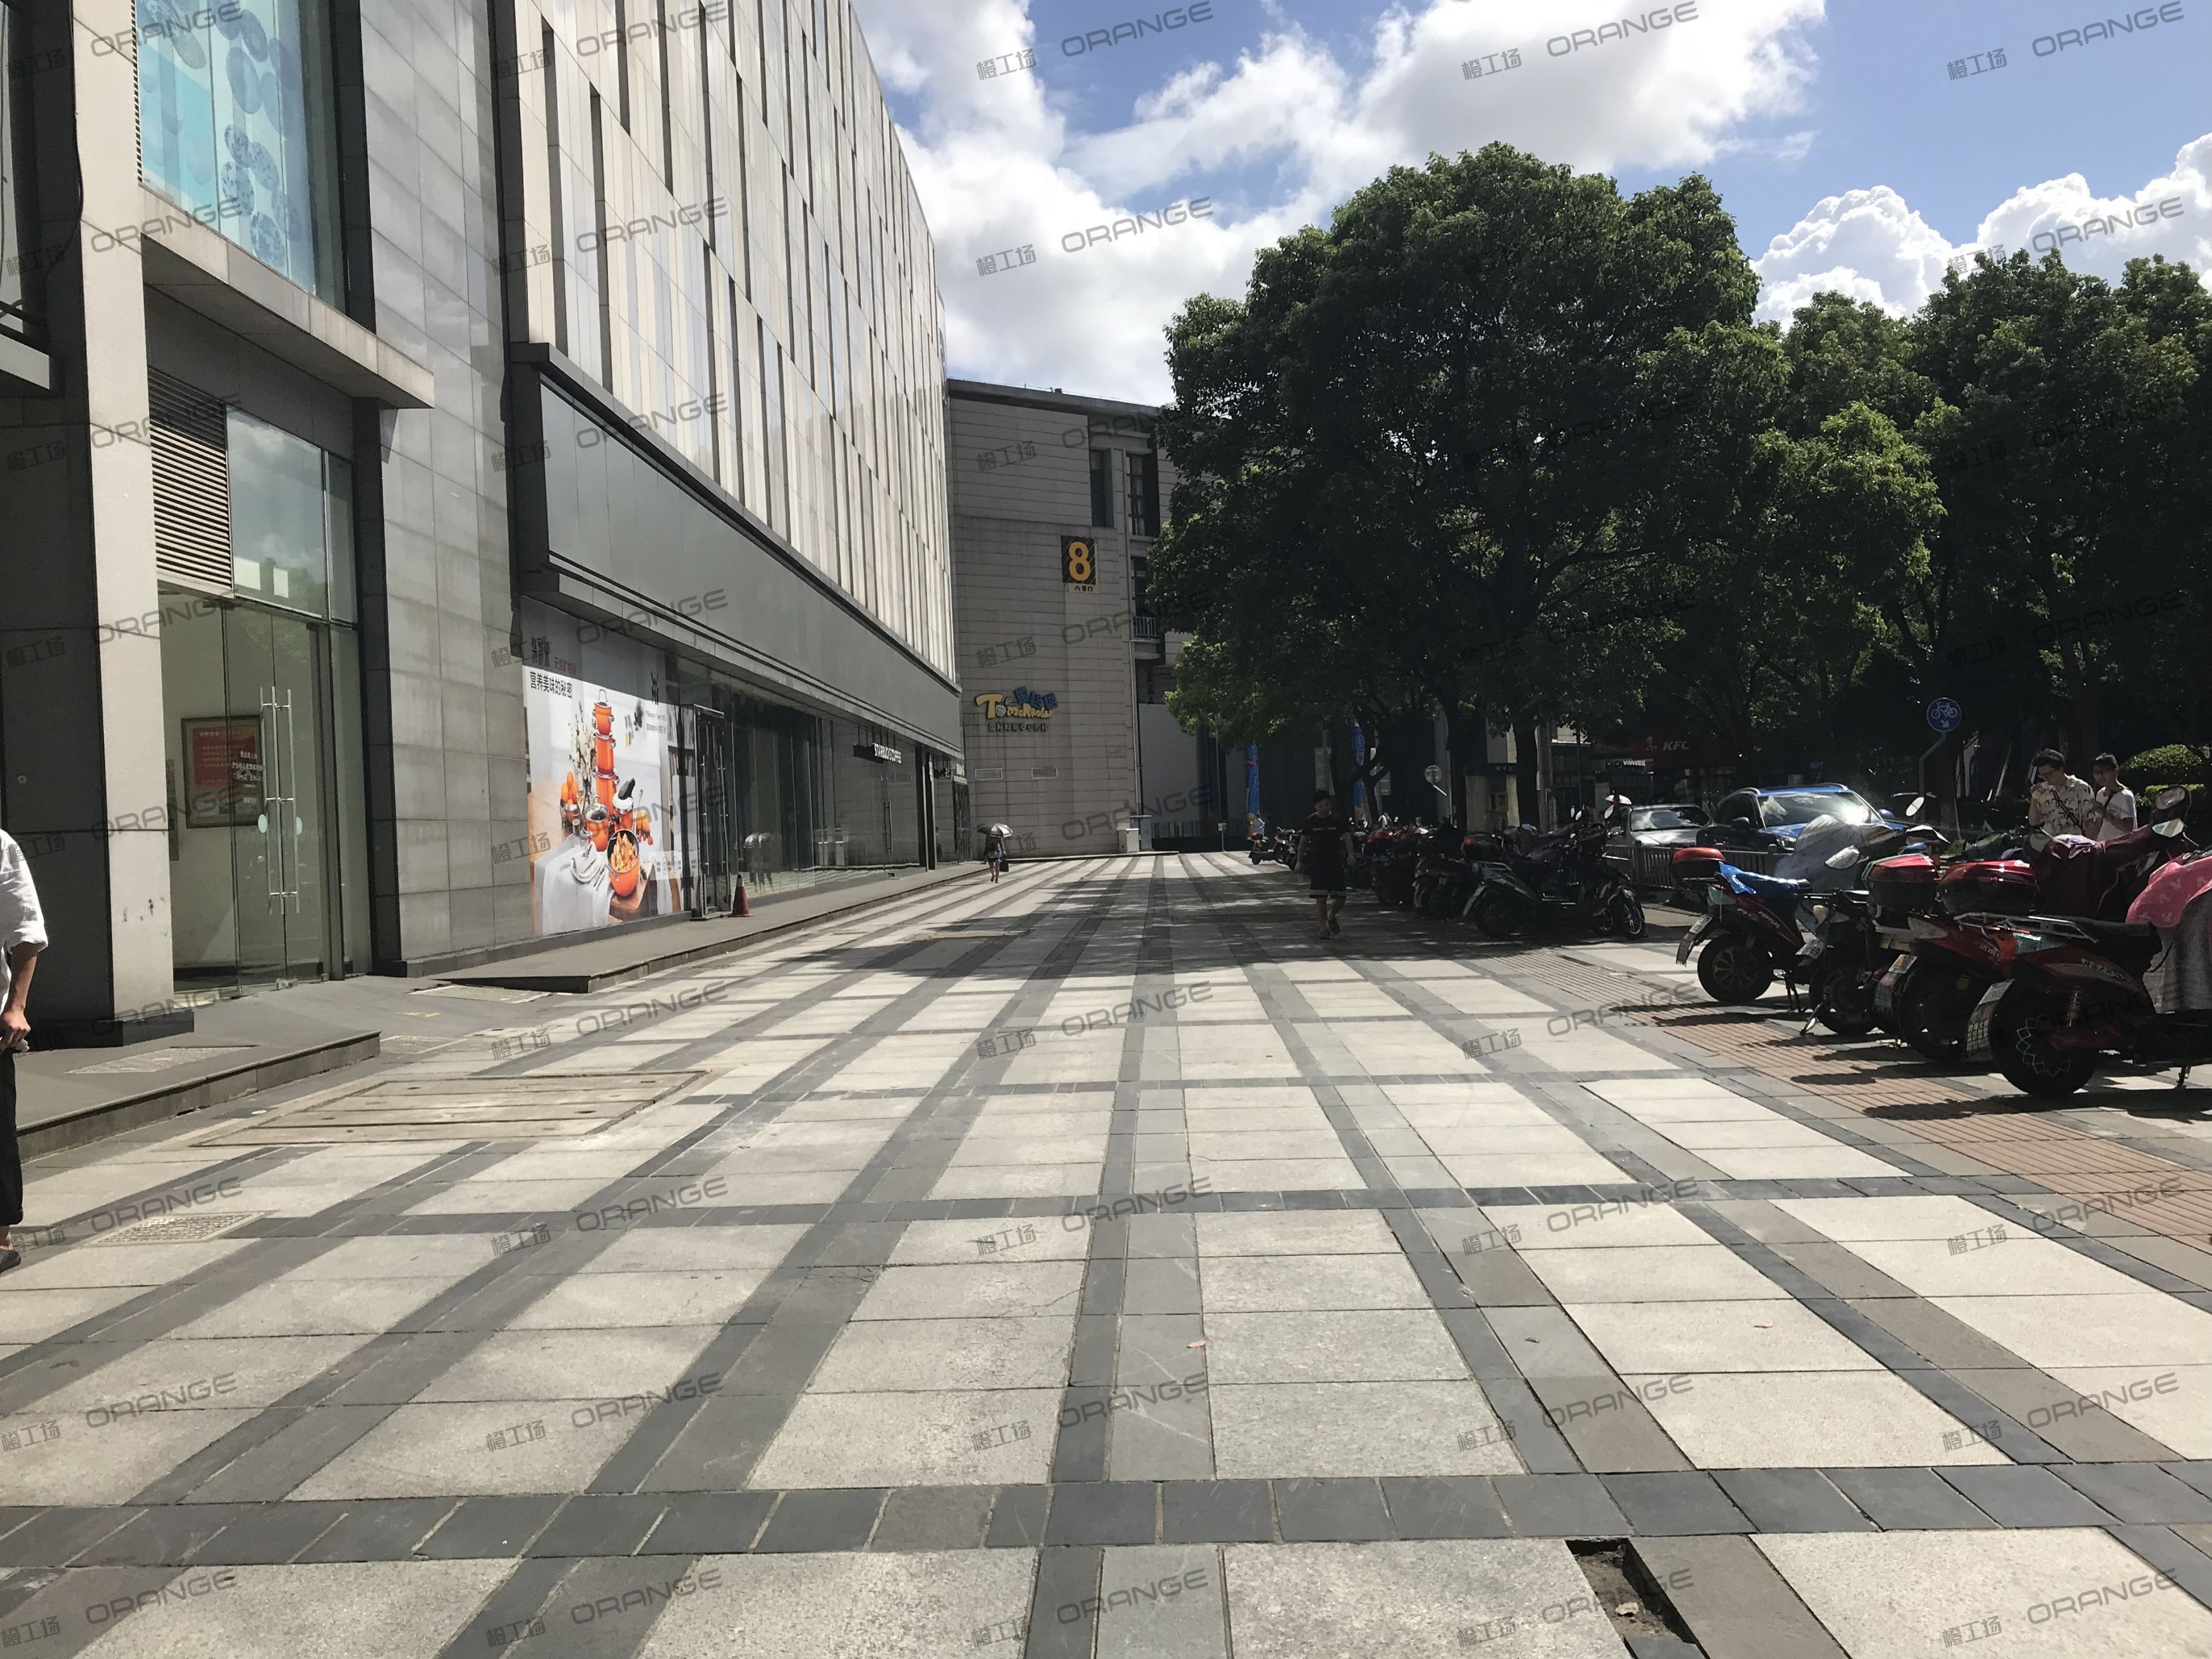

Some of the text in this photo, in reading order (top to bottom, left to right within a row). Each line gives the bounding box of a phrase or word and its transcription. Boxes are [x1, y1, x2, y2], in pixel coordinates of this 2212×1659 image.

[1069, 541, 1091, 581] 8
[530, 671, 573, 699] 营养美味的秘密
[1662, 740, 1689, 751] KFC
